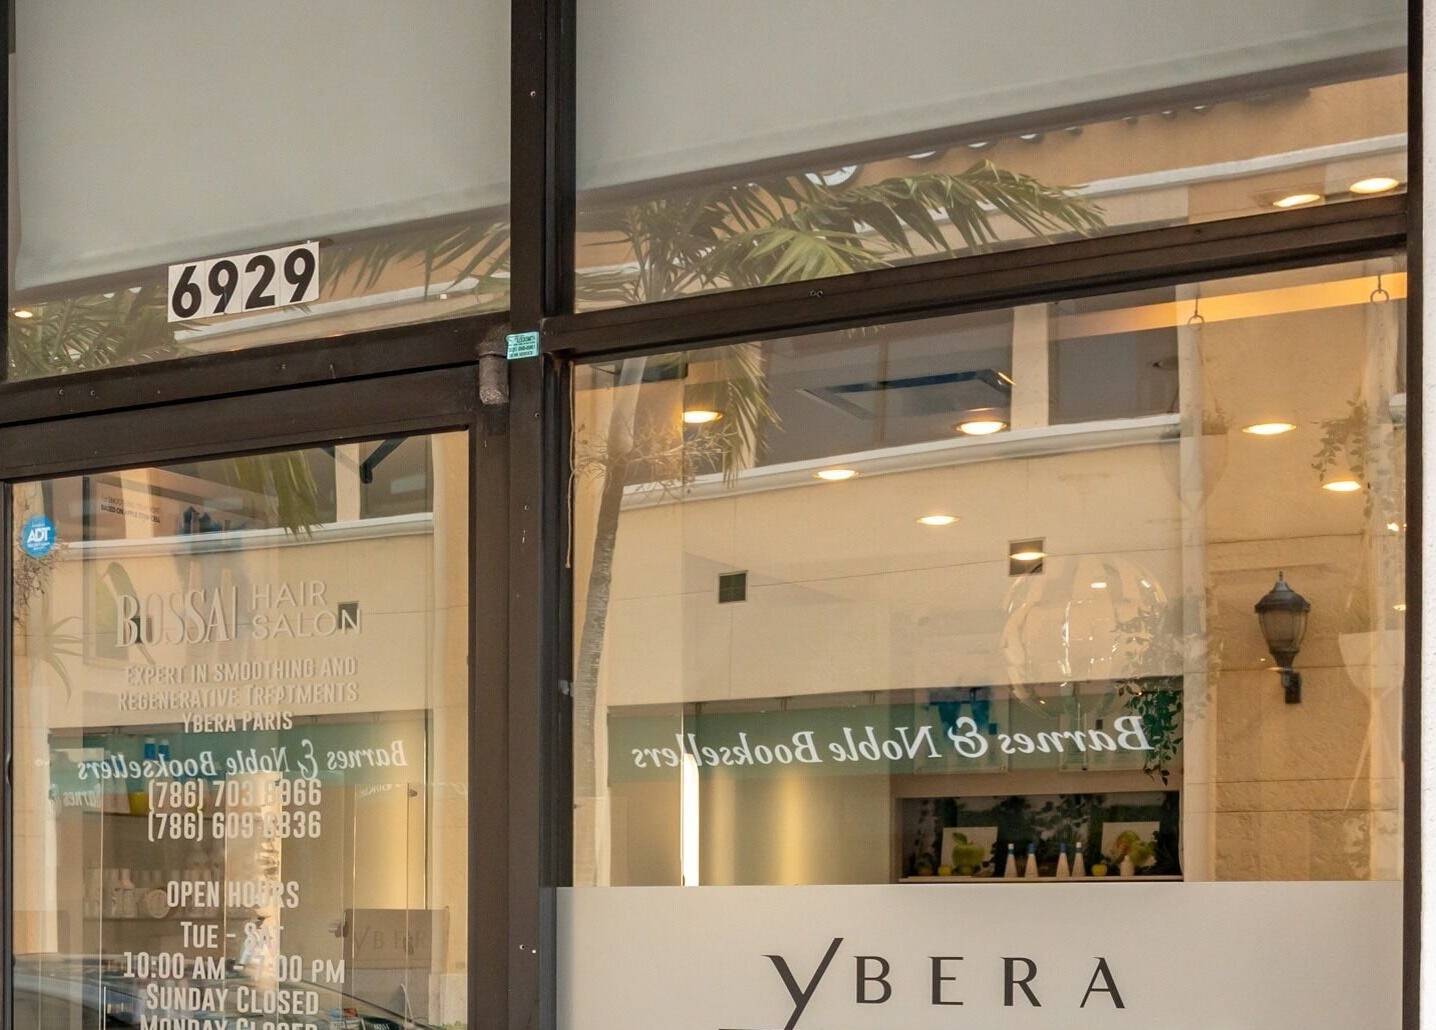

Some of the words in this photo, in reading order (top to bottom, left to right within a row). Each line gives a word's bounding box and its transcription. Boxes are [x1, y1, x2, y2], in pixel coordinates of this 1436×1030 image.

[171, 247, 317, 319] 6929
[27, 526, 51, 543] ADT
[251, 580, 328, 610] HAIR
[114, 587, 231, 648] BOSSA
[251, 609, 362, 640] SALON
[125, 664, 186, 686] EXPERT
[191, 663, 208, 683] IN
[214, 658, 315, 682] SMOOTHING
[321, 656, 357, 676] AND
[119, 687, 239, 712] REGENERATIVE
[182, 712, 237, 733] YBERA
[242, 711, 293, 731] PARIS
[148, 778, 204, 811] (786)
[148, 810, 204, 842] (786)
[167, 880, 220, 908] OPEN
[227, 880, 300, 909] HOURS
[180, 921, 219, 948] TUE
[123, 952, 185, 980] 10:00
[192, 956, 225, 980] AM
[311, 959, 345, 984] PM
[146, 983, 228, 1013] SUNDAY
[237, 985, 319, 1015] CLOSED
